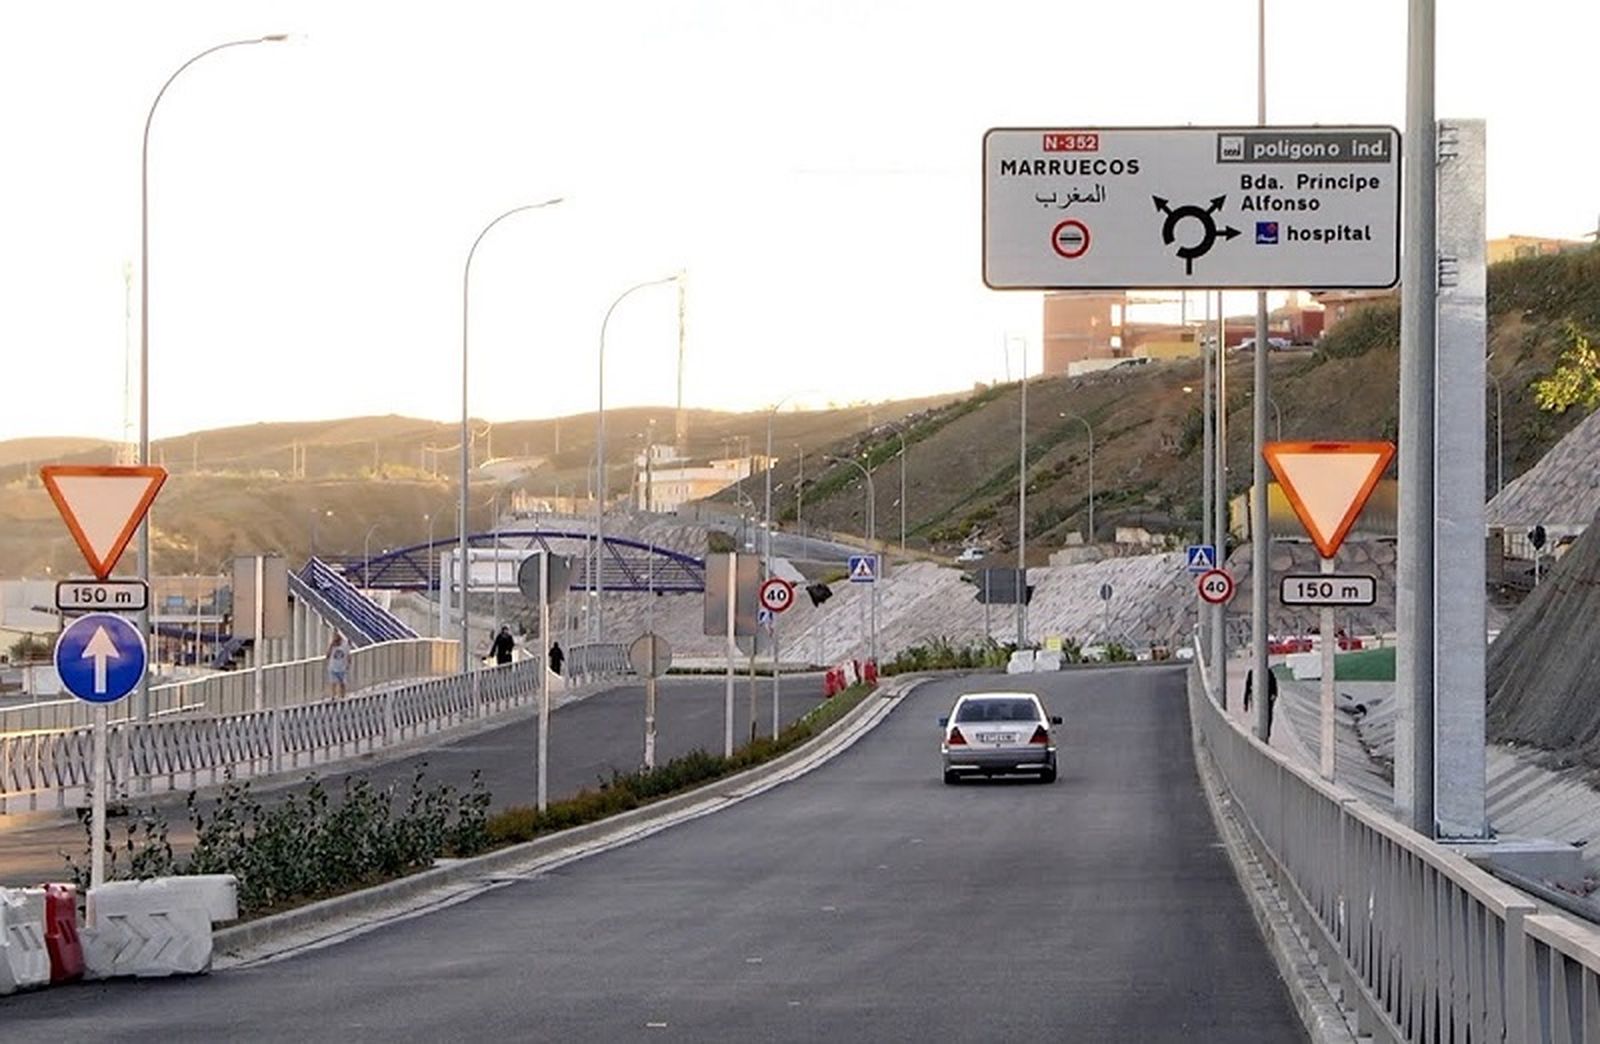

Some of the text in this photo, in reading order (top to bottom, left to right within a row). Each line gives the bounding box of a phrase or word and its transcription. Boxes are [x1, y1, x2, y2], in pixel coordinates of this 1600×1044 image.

[1045, 136, 1098, 150] N-352
[1352, 140, 1388, 156] ind.
[1001, 159, 1140, 176] MARRUECOS
[1240, 174, 1284, 190] Bda.
[1035, 183, 1106, 210] المغرب
[1241, 195, 1321, 211] Alfonso
[1287, 225, 1372, 243] hospital
[74, 588, 131, 602] 150 m
[767, 590, 786, 601] 40
[1205, 582, 1225, 593] 40
[1298, 583, 1359, 597] 150 m
